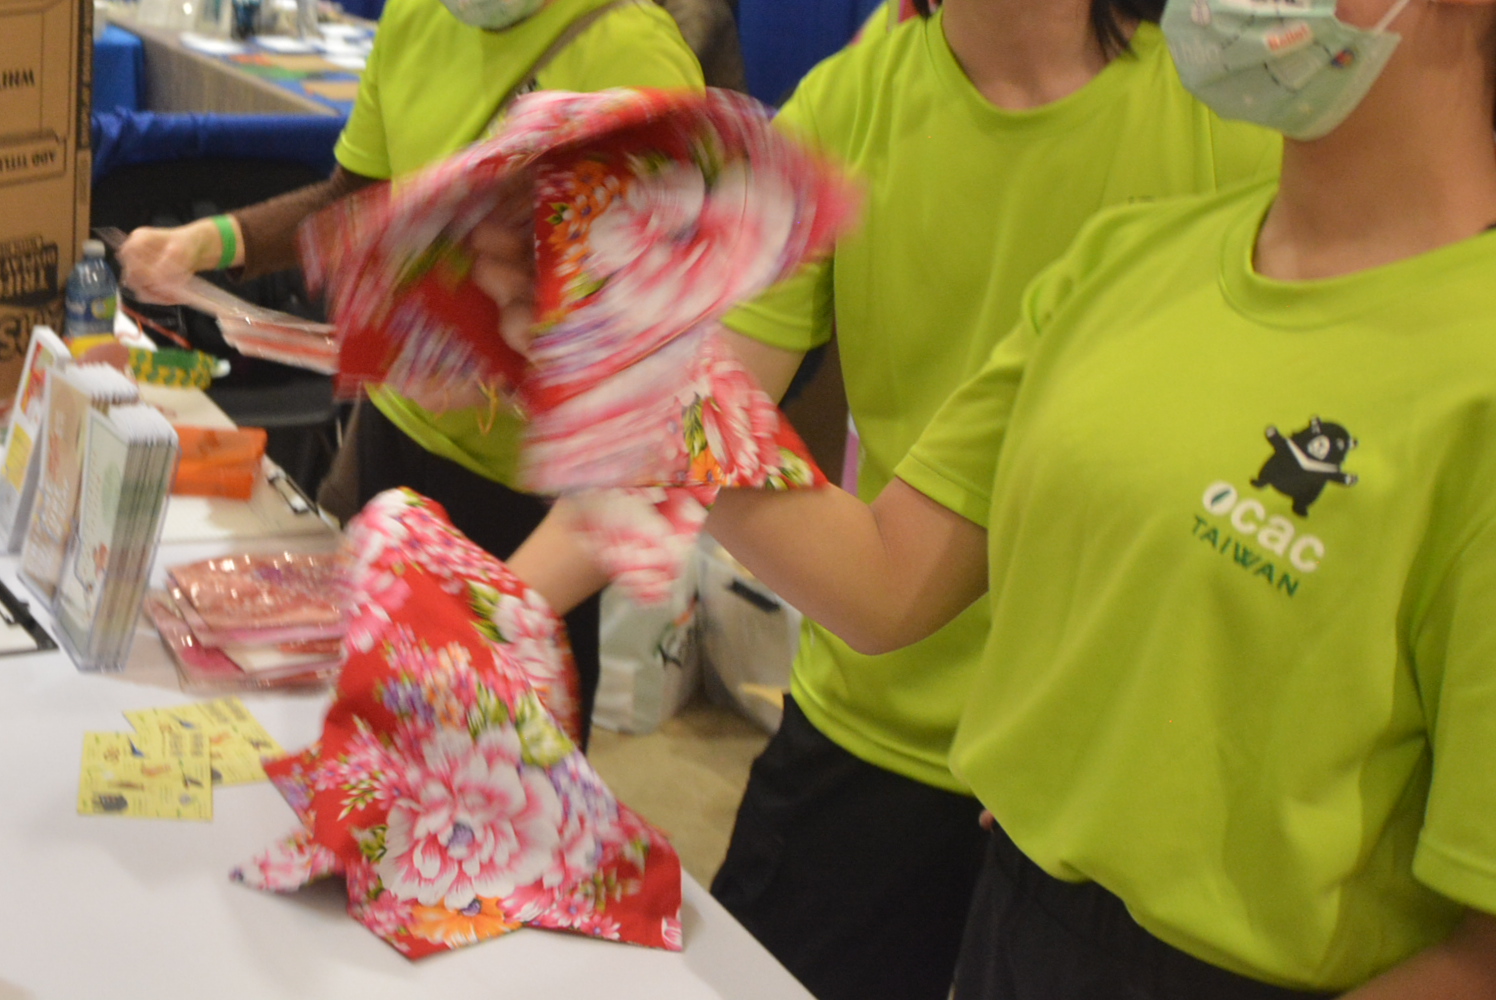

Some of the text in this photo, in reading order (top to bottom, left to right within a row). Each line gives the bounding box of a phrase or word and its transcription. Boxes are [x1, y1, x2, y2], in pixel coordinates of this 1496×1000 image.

[31, 151, 56, 168] ADD
[1191, 515, 1299, 598] TAIWAN
[1202, 480, 1325, 573] ocac
